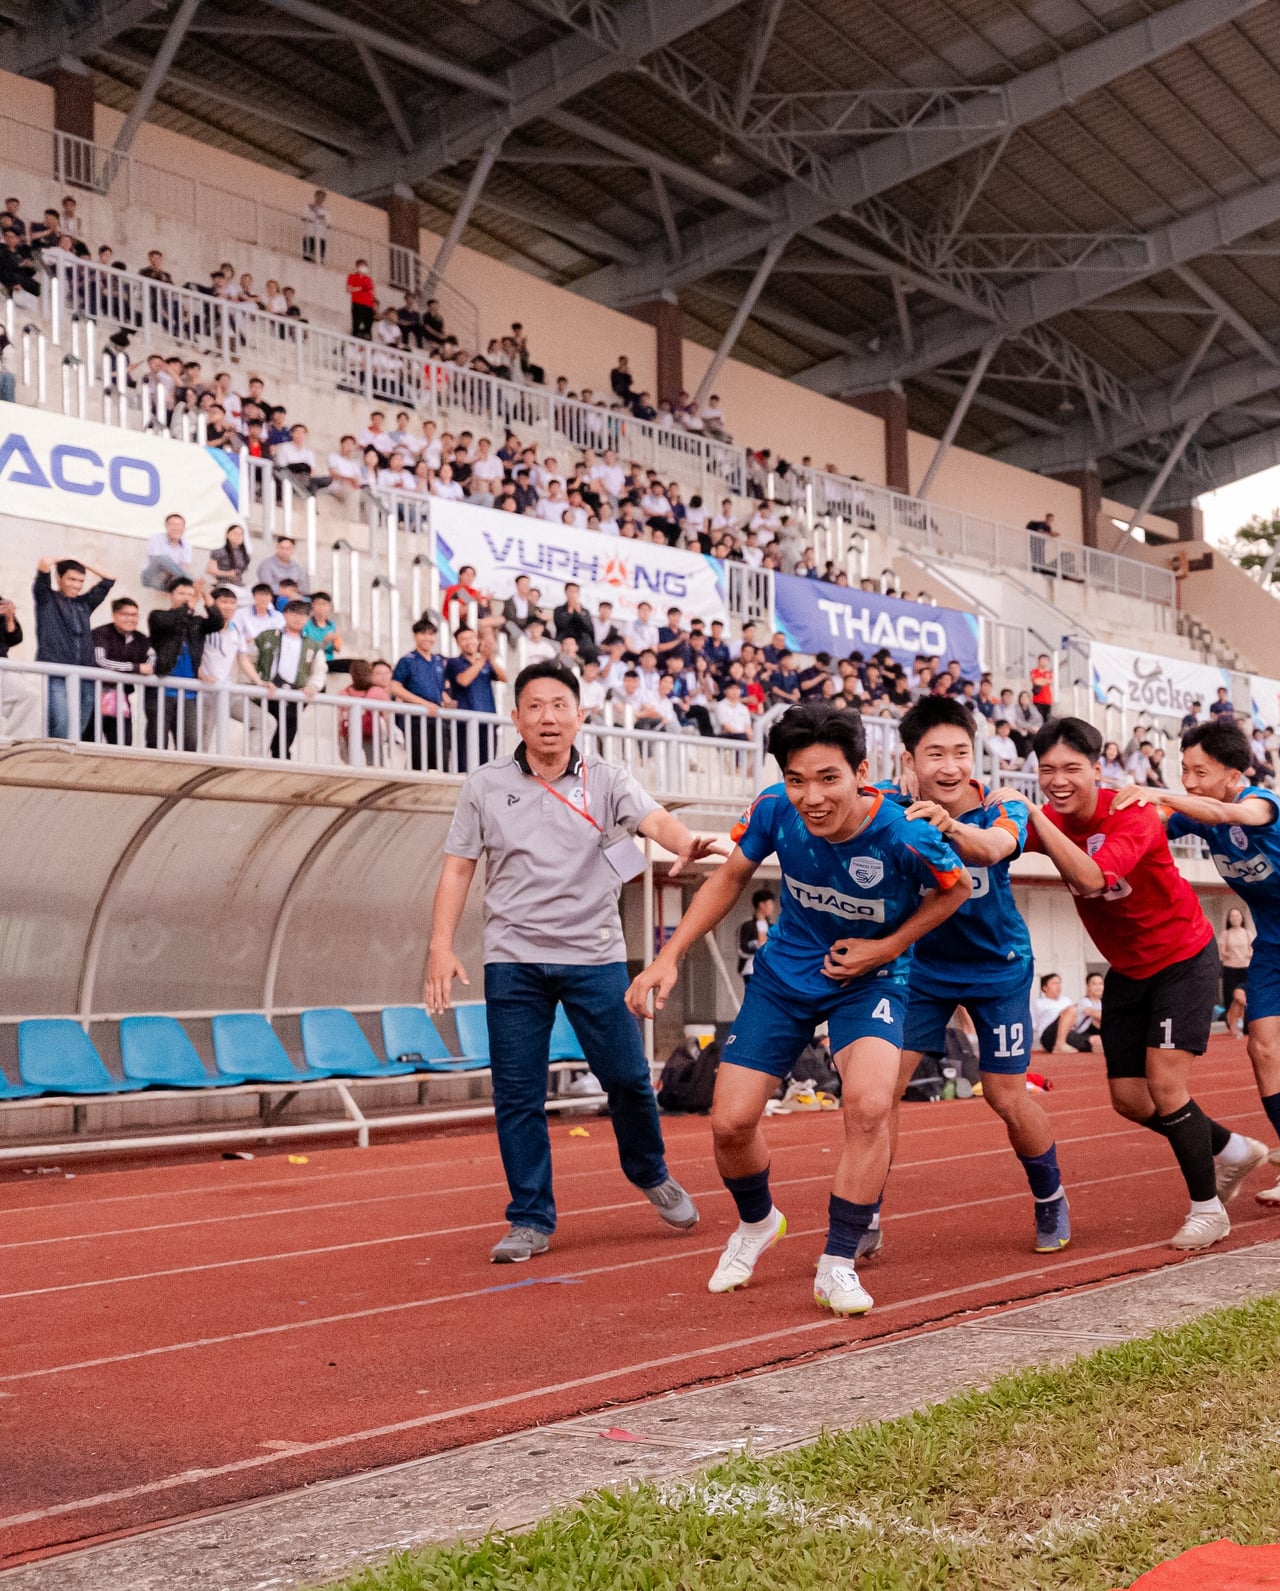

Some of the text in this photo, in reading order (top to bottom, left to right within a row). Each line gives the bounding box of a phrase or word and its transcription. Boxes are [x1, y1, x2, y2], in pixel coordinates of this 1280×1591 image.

[817, 598, 948, 656] THACO
[791, 885, 875, 917] THACO
[871, 997, 895, 1025] 4
[992, 1022, 1025, 1058] 12
[1159, 1017, 1176, 1049] 1
